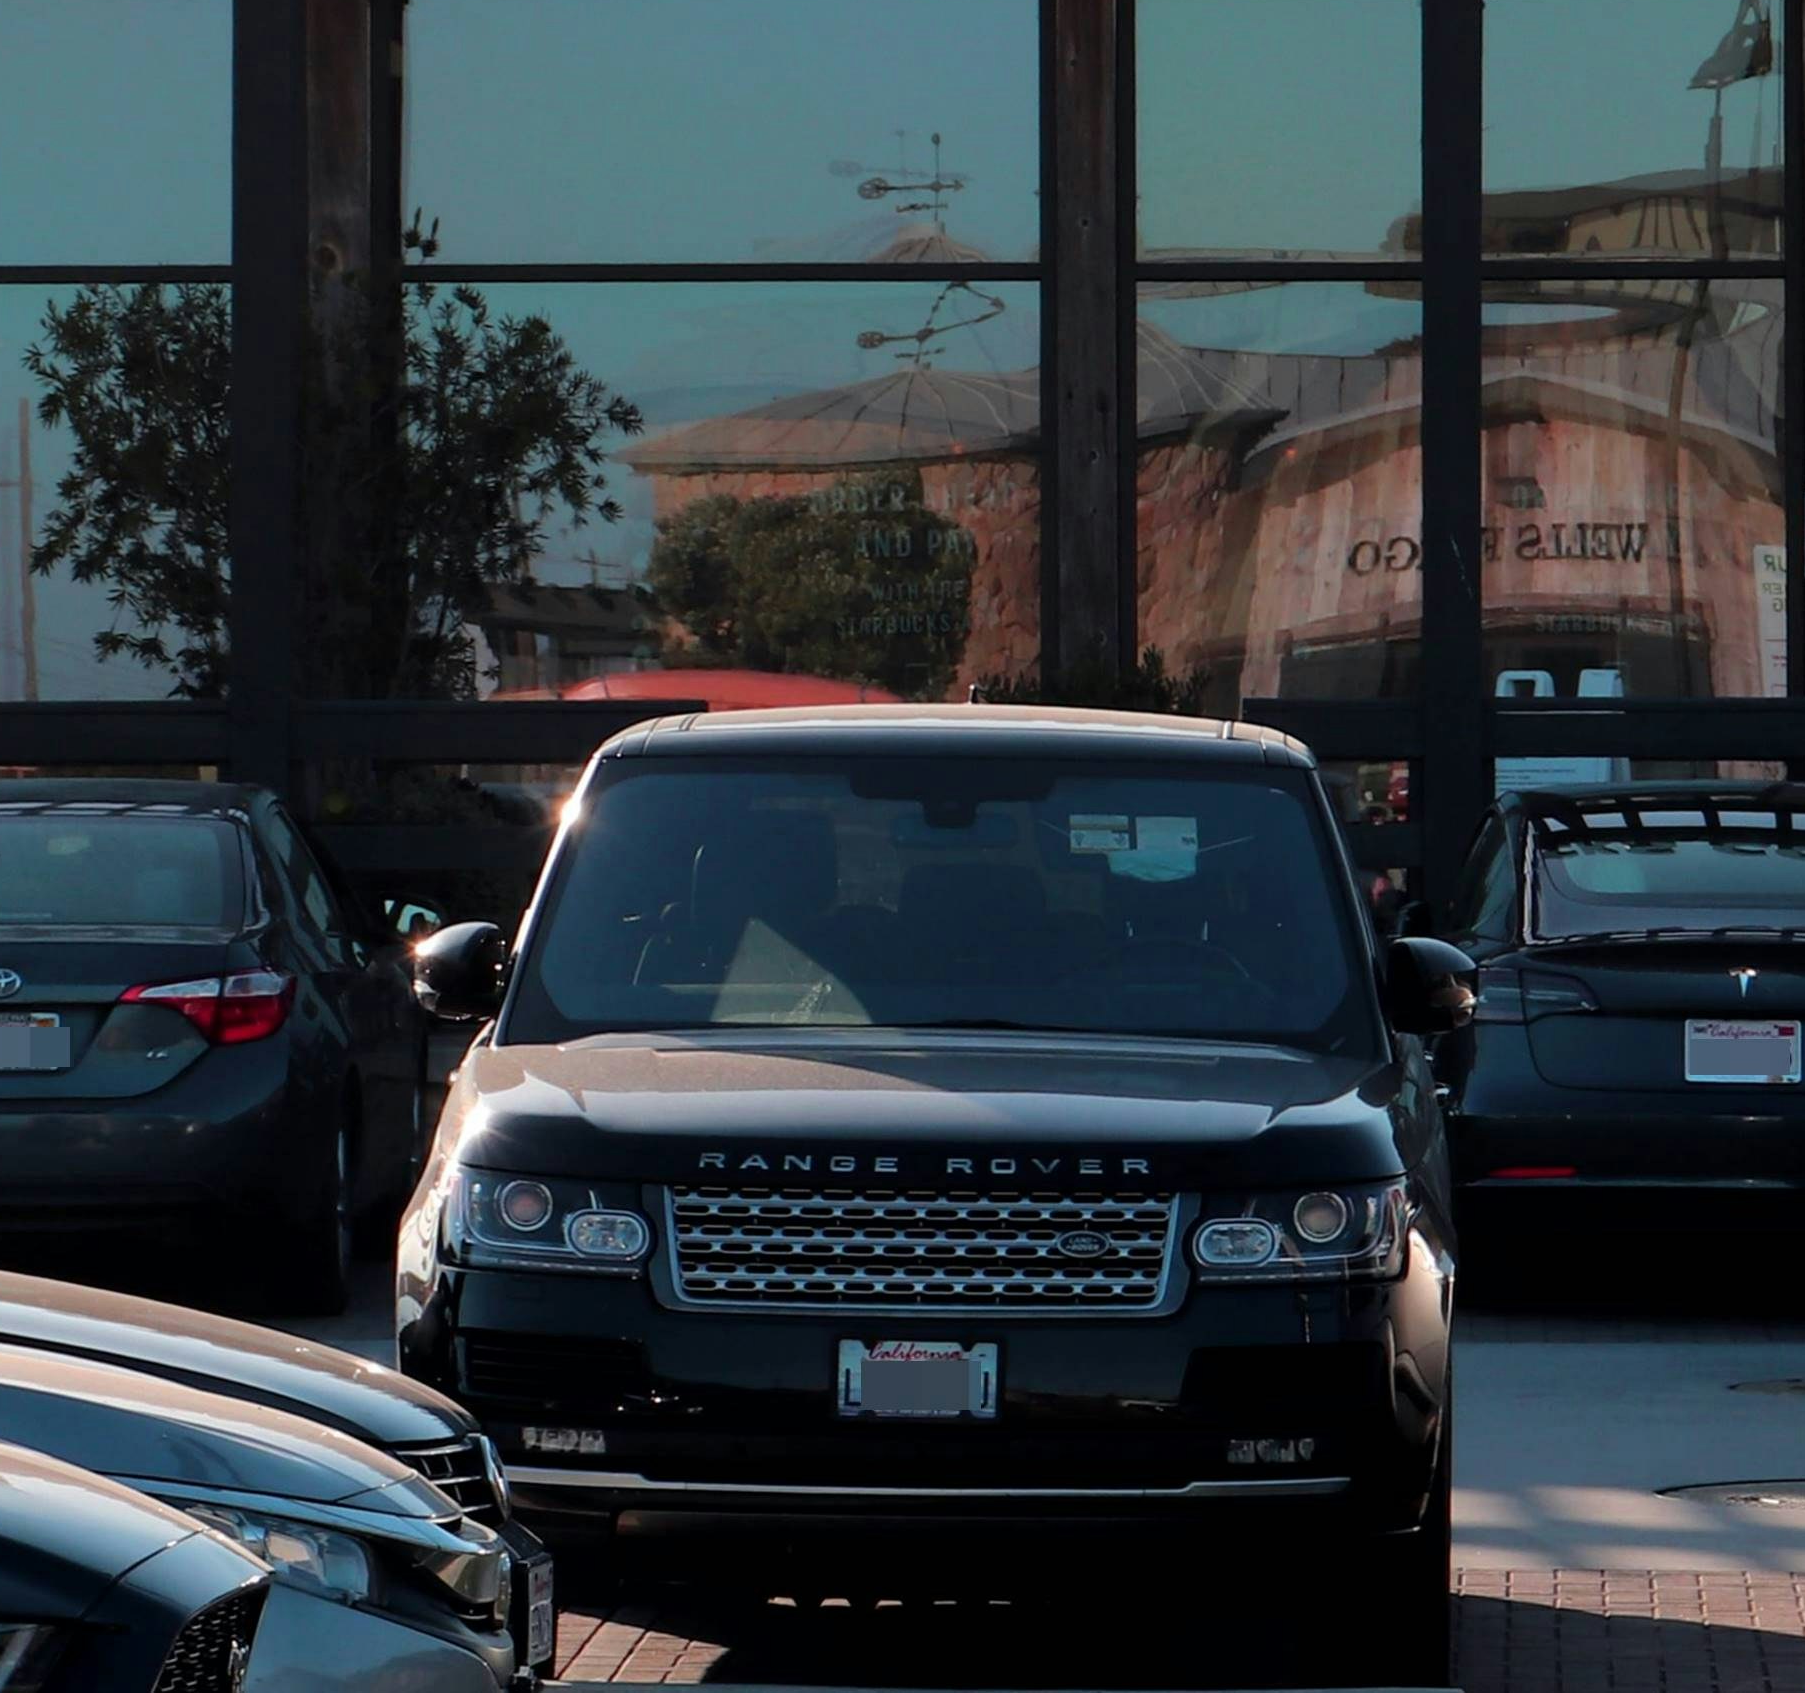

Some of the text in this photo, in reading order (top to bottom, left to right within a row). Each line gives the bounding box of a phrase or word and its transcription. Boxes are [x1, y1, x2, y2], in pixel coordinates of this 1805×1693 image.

[854, 528, 912, 557] AND
[835, 614, 952, 637] STARBUCKS
[697, 1152, 1150, 1175] RANGE ROVER
[868, 1340, 965, 1363] California
